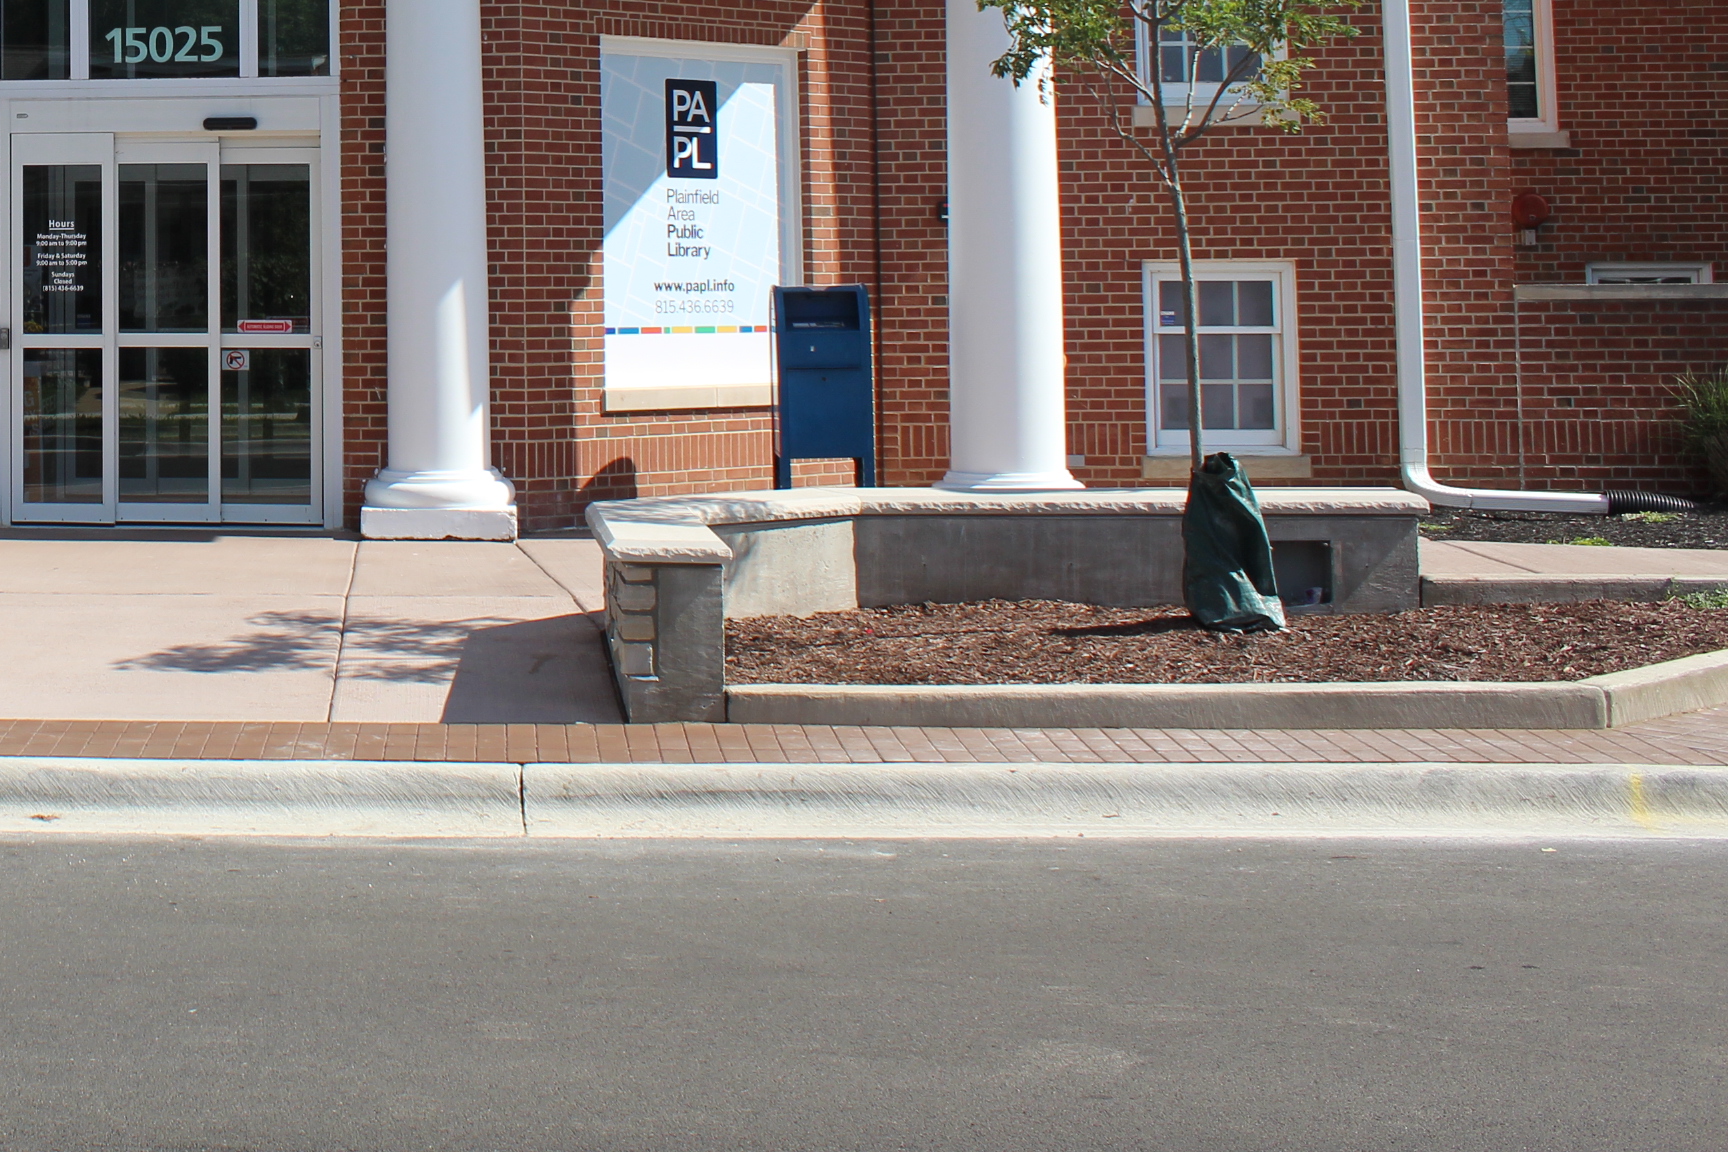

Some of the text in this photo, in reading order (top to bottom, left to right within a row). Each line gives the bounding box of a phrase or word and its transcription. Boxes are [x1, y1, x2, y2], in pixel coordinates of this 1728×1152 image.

[105, 26, 224, 64] 15025
[672, 89, 710, 123] PA
[673, 135, 712, 169] PL
[666, 188, 720, 204] Plainfield
[667, 206, 695, 221] Area
[48, 219, 75, 228] Hours
[667, 224, 704, 239] Public
[667, 242, 711, 260] Library
[654, 279, 735, 294] www.papl.info
[655, 299, 734, 314] 815.436.6639
